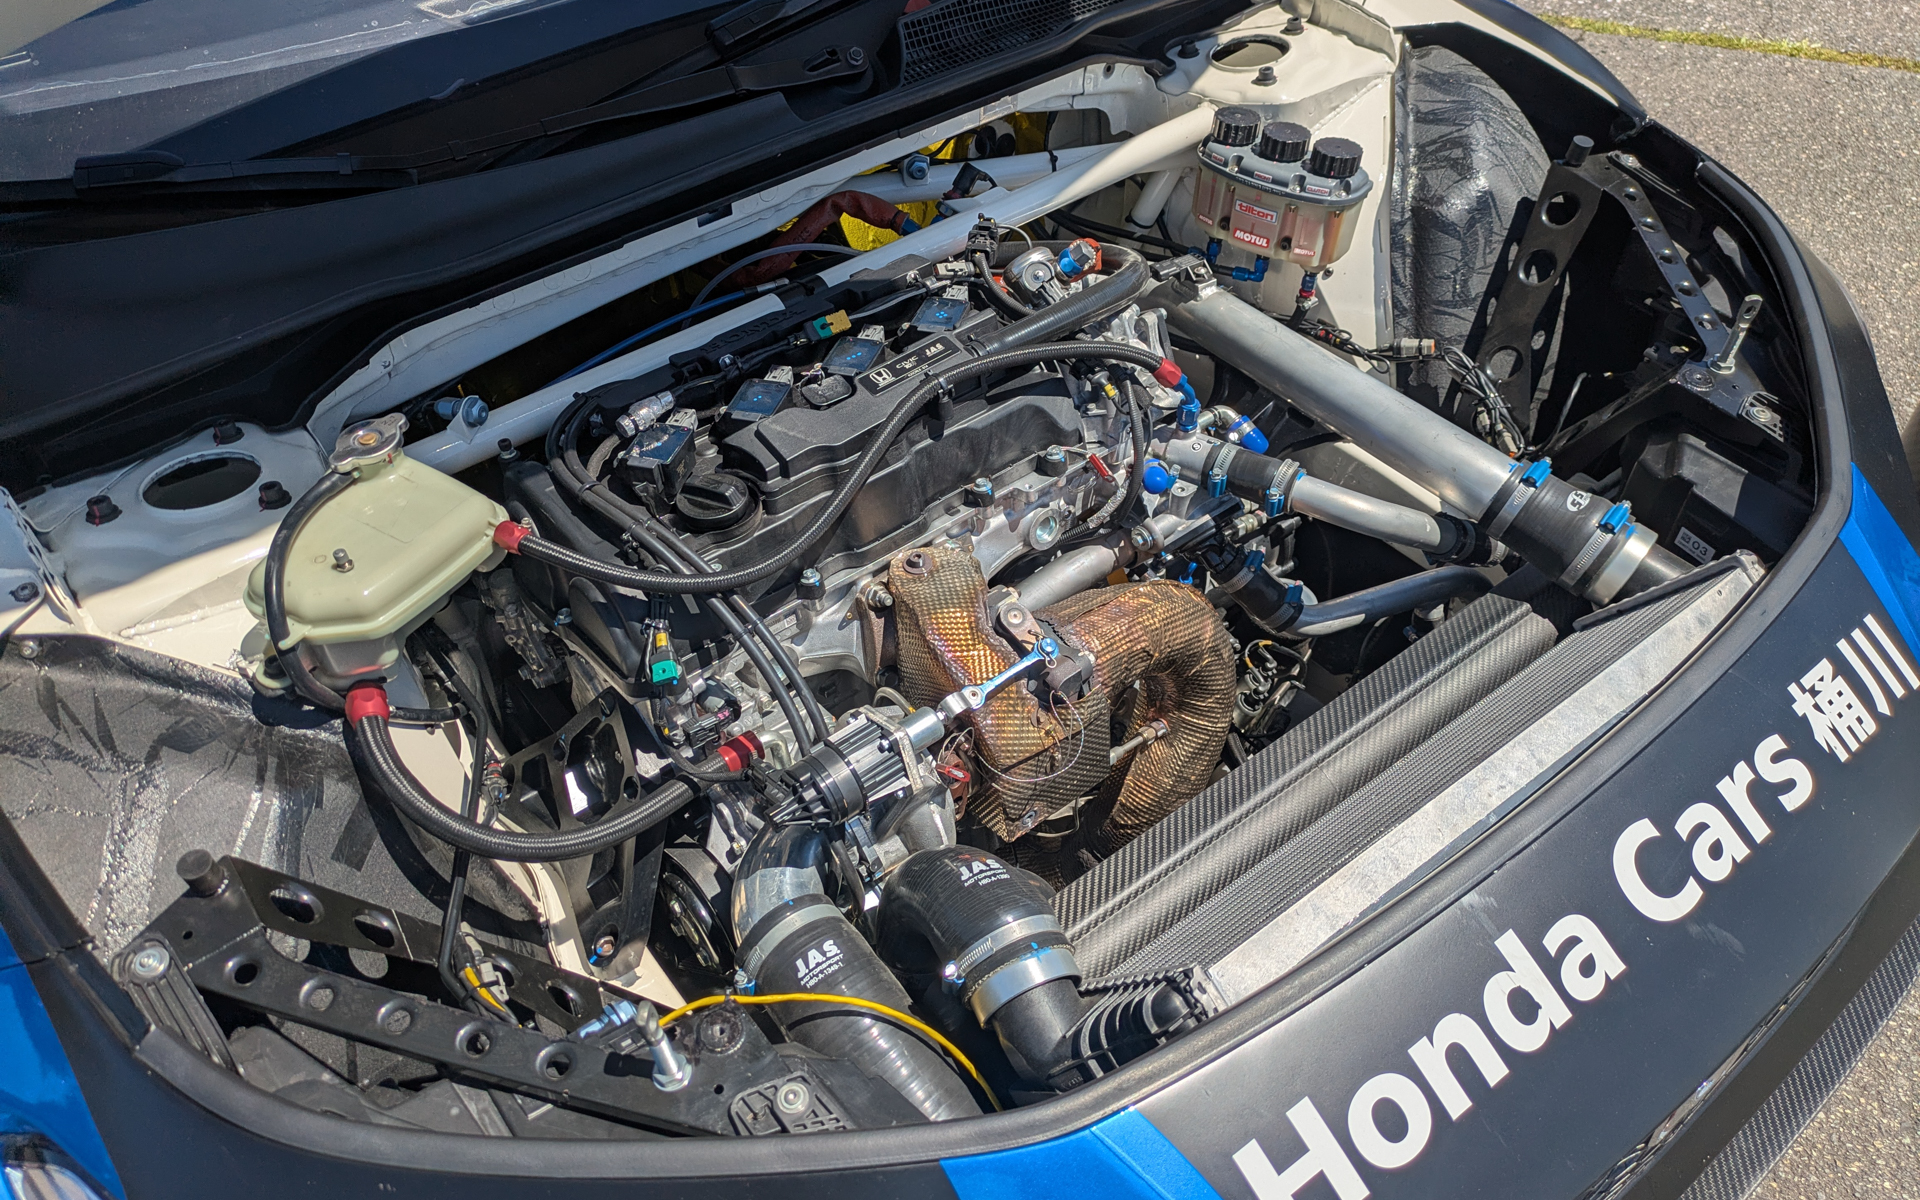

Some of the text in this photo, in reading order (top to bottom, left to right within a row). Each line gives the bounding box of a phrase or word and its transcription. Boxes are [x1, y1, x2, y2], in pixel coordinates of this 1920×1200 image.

[1306, 186, 1329, 195] CLUTCH
[1237, 202, 1275, 222] tilton
[1234, 229, 1269, 247] MOTUL
[1294, 247, 1315, 256] MOTUL
[896, 355, 919, 369] CIVIC
[964, 868, 1007, 887] MOTORSPORT
[1232, 613, 1920, 1200] Honda Cars 桶川
[795, 939, 841, 979] J.A.S.
[800, 953, 844, 986] MOTORSPORT
